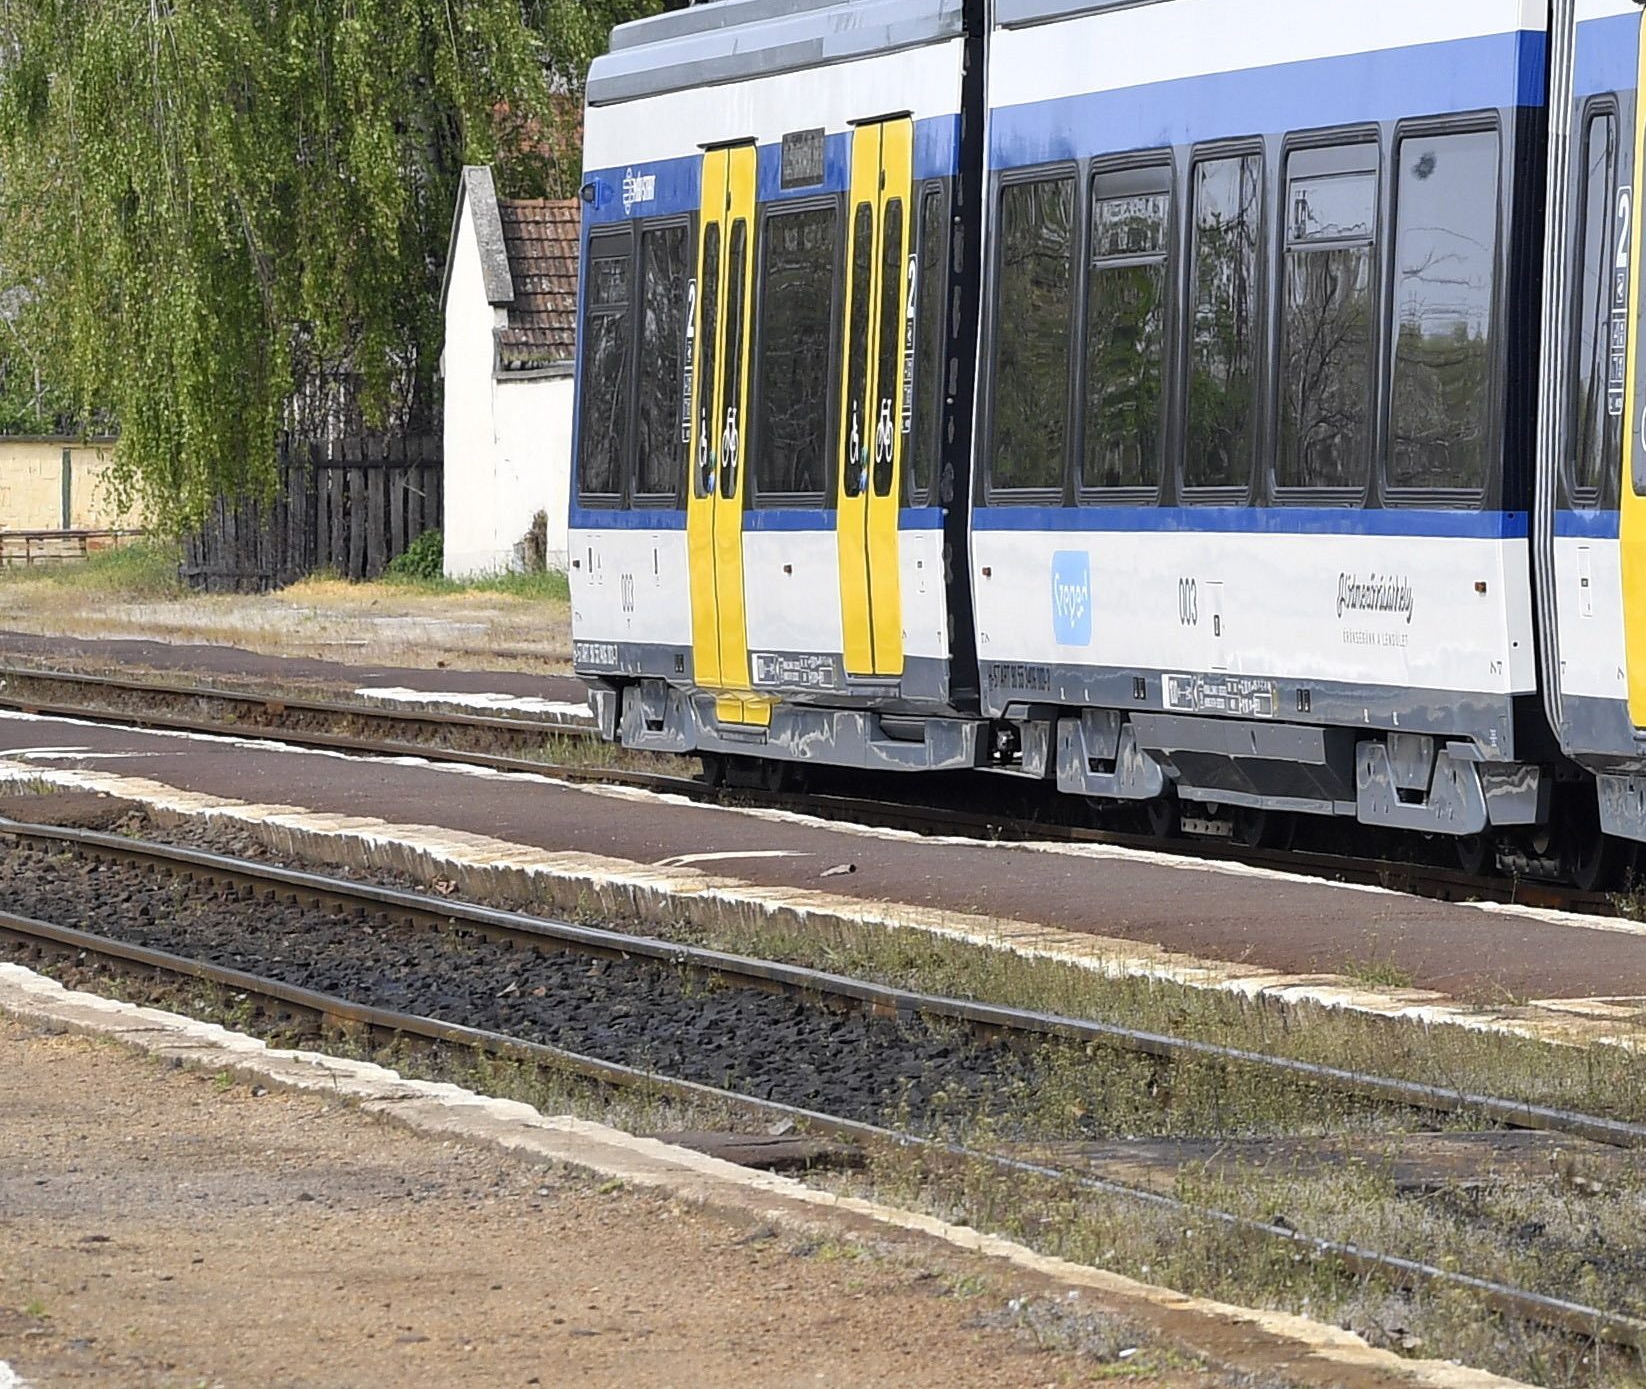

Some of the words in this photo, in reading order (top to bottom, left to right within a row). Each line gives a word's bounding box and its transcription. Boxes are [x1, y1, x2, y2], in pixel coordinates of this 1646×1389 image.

[1616, 193, 1630, 268] 2
[687, 284, 696, 338] 2
[907, 259, 917, 314] 2
[620, 573, 634, 613] 003
[1178, 577, 1198, 626] 003
